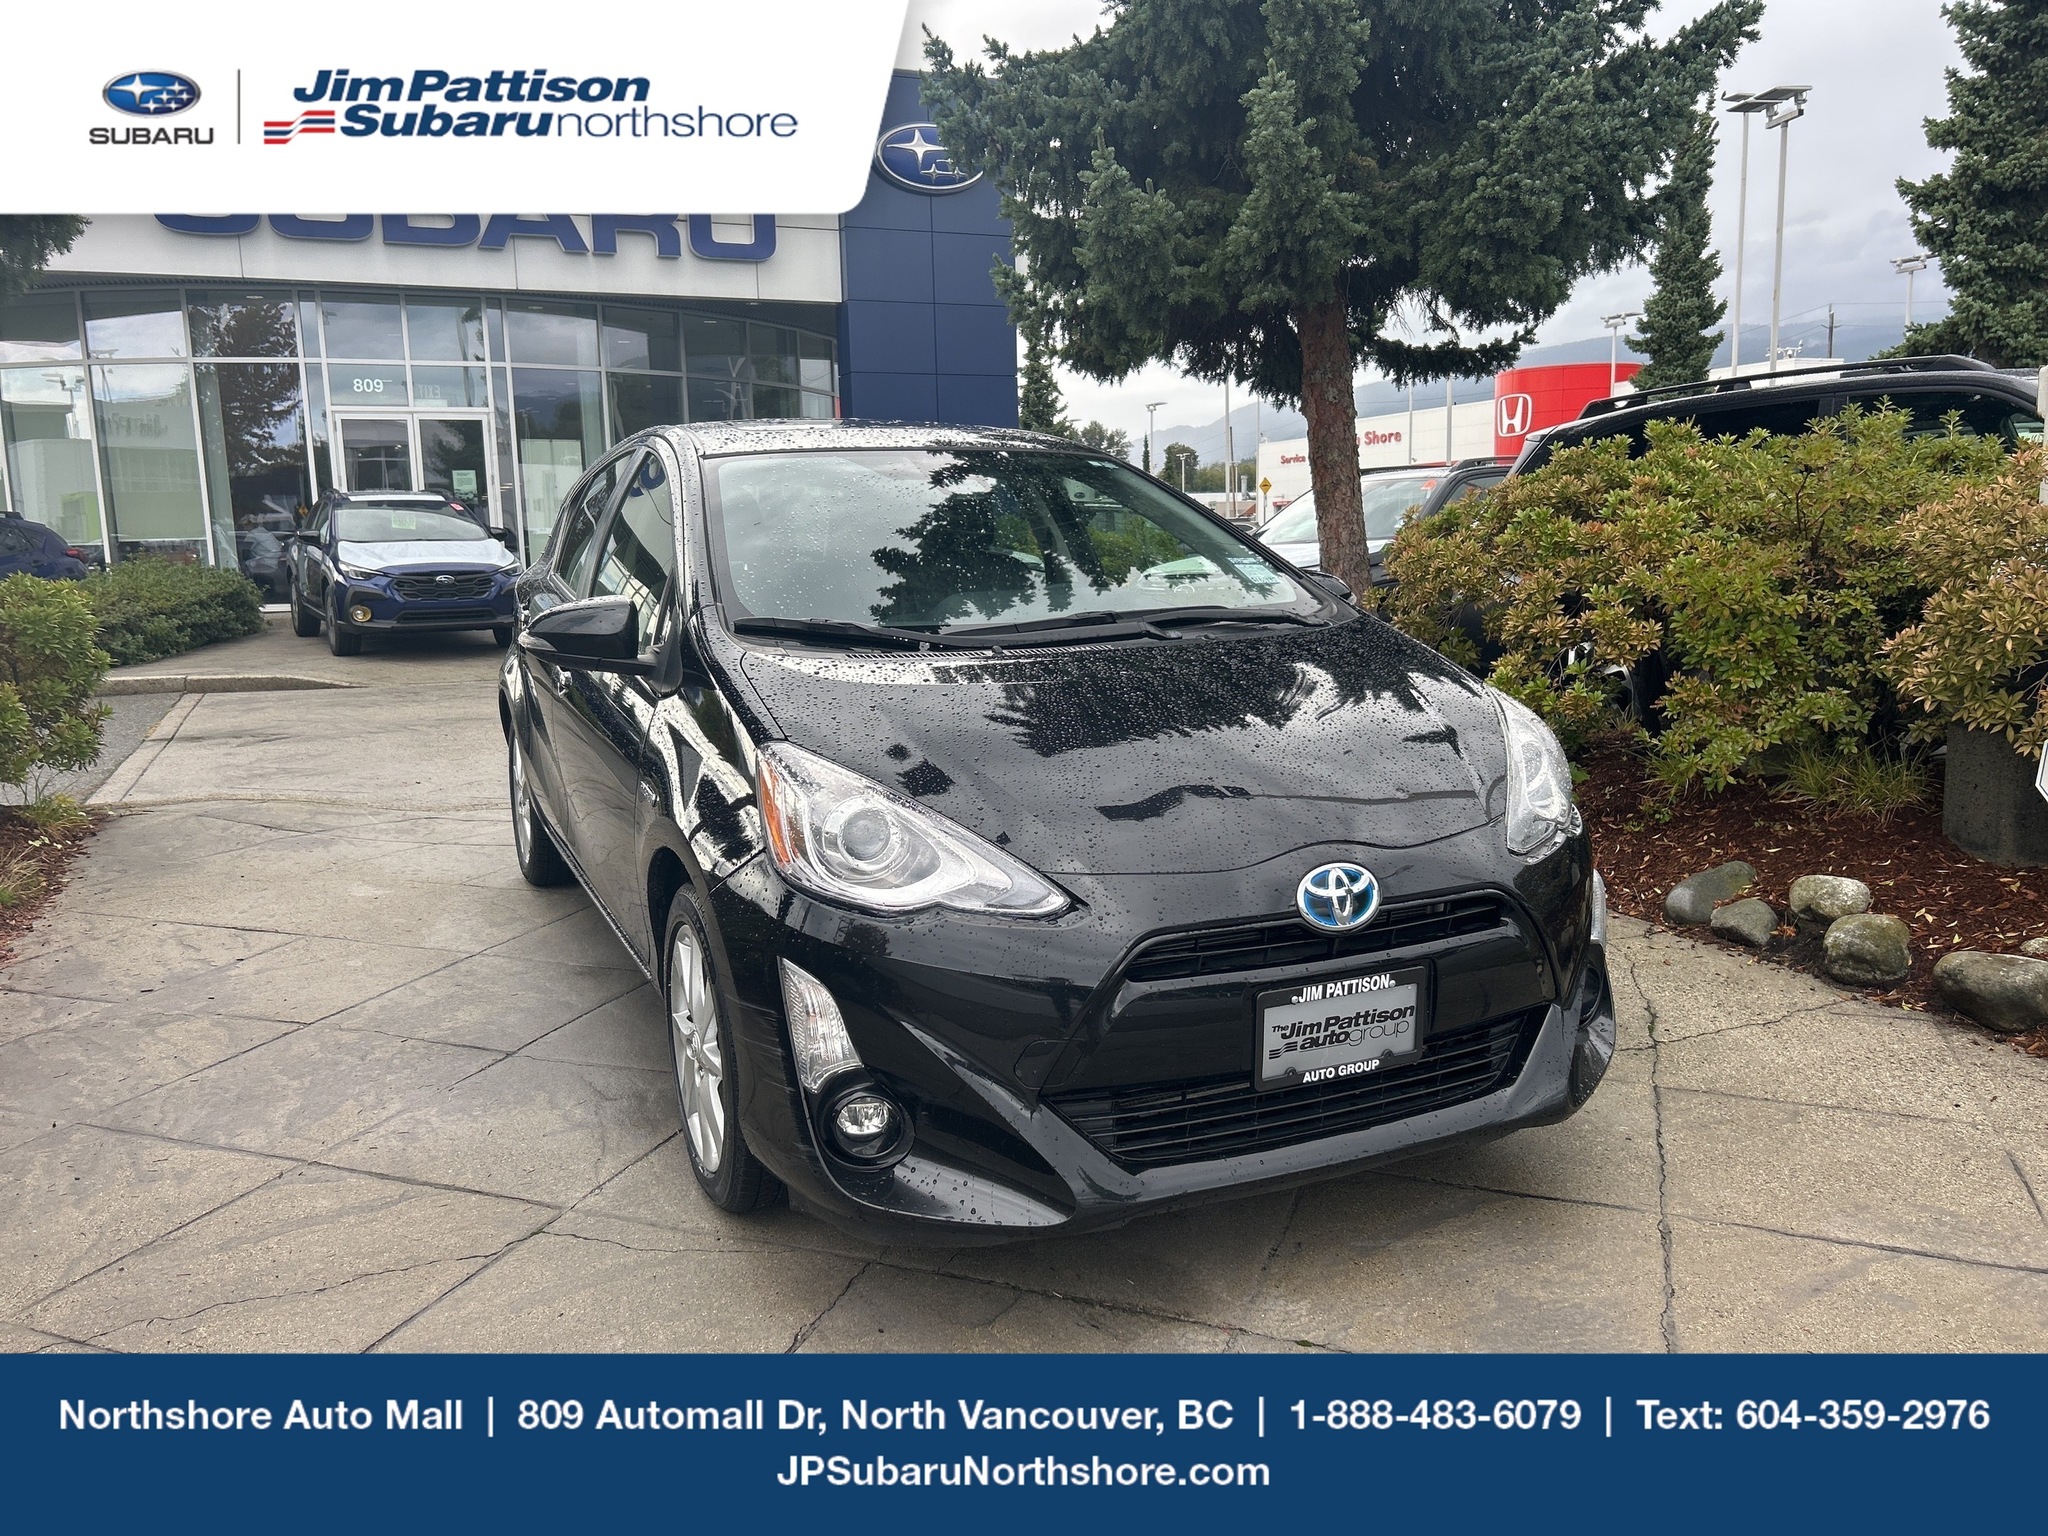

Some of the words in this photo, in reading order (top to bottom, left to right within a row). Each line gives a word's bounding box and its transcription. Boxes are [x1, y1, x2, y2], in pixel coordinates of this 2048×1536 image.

[353, 379, 384, 393] 809
[1364, 431, 1402, 446] Shore
[1280, 454, 1306, 465] Service
[1299, 987, 1322, 1003] JIM
[1326, 974, 1390, 998] PATTISON
[1272, 1023, 1289, 1033] The
[1281, 1020, 1322, 1040] Jim
[1322, 1004, 1416, 1033] Pattison
[1302, 1065, 1336, 1084] AUTO
[1338, 1059, 1380, 1077] GROUP
